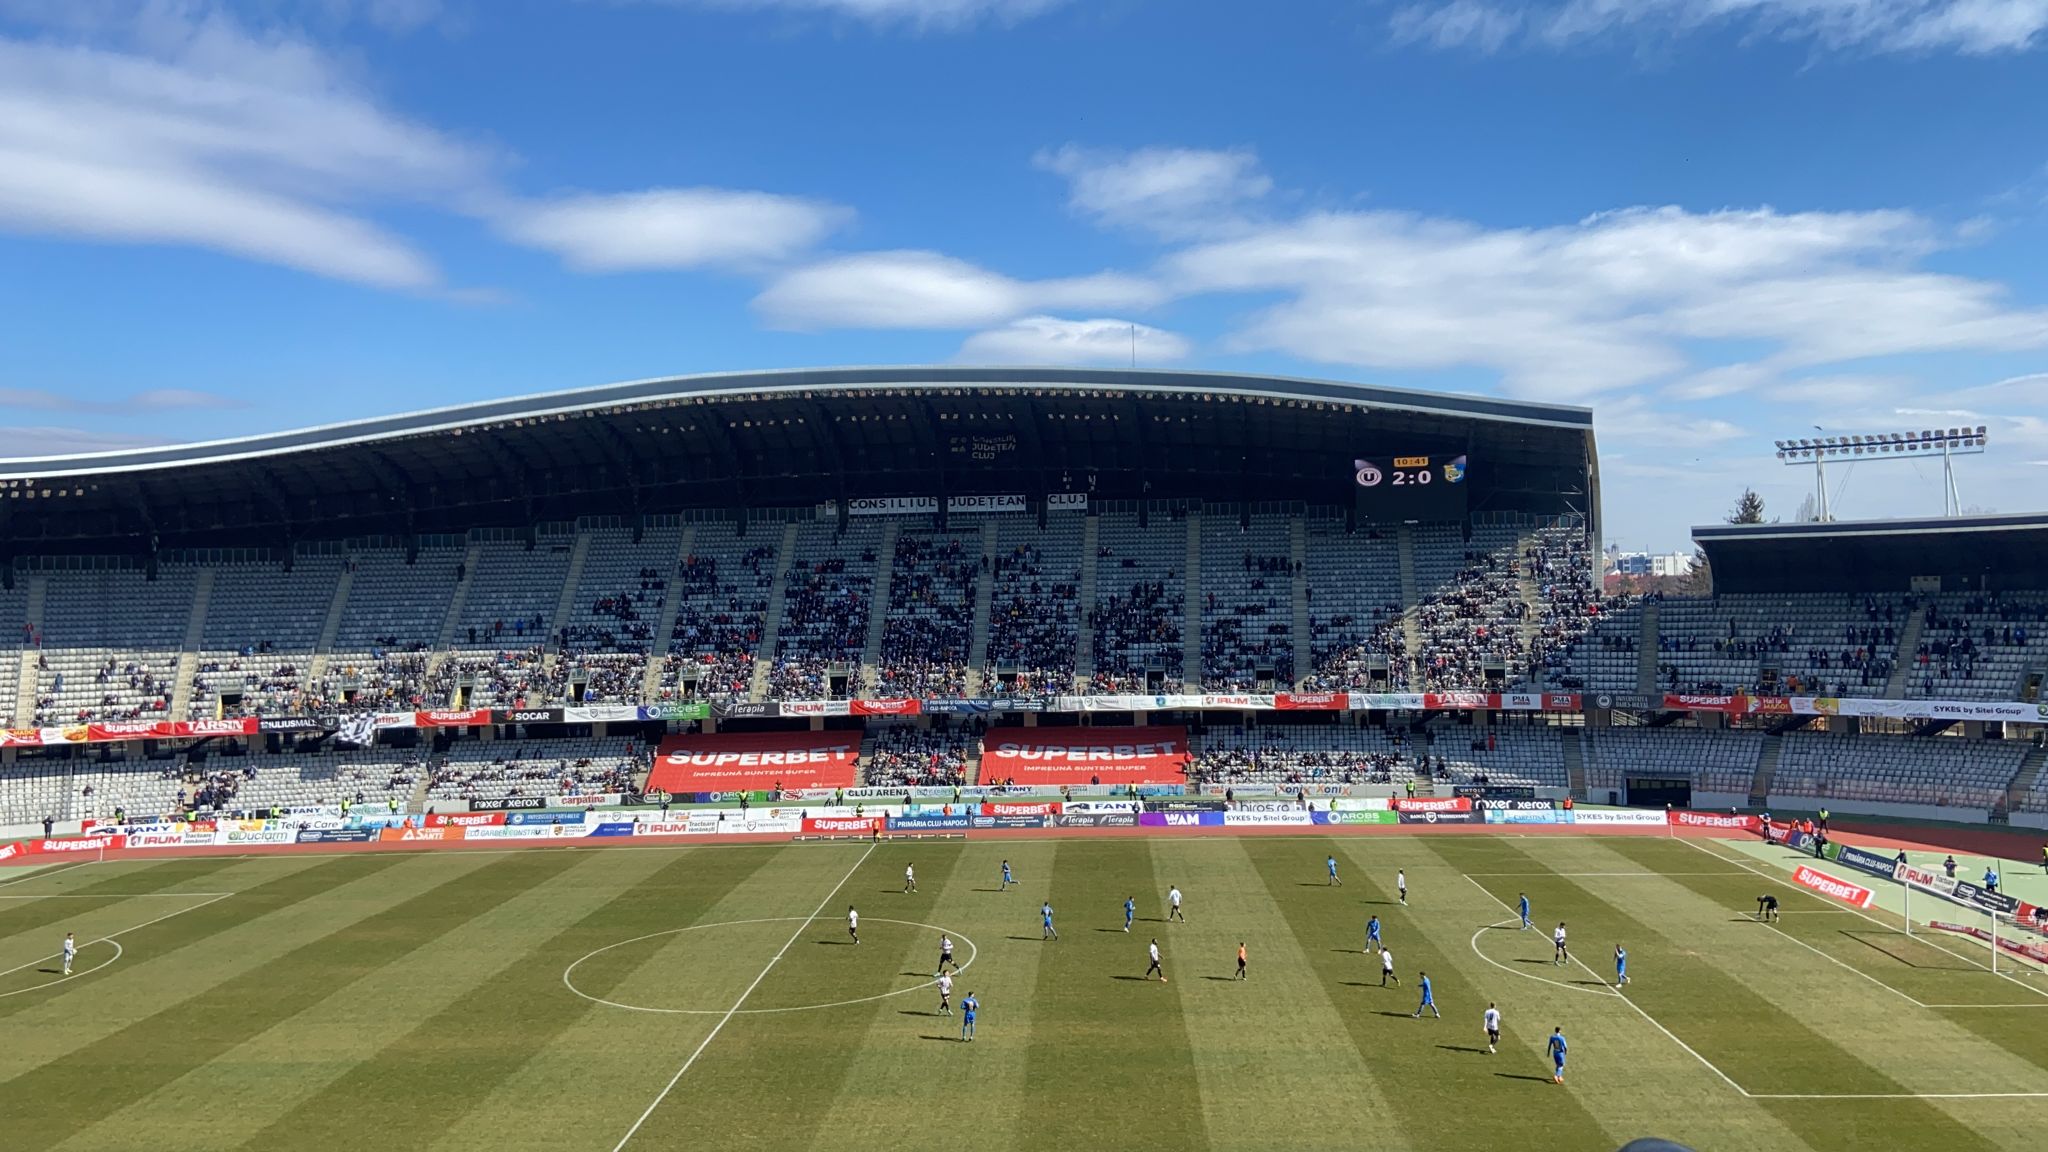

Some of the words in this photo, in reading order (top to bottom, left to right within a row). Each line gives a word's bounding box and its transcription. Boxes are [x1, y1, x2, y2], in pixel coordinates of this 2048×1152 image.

[1392, 470, 1432, 485] 2:0
[850, 497, 937, 510] CONSILIUL
[1050, 494, 1086, 504] CLUJ
[1290, 694, 1336, 703] SUPERBET
[1680, 695, 1732, 704] SUPERBET
[734, 704, 765, 714] Terapia
[794, 704, 824, 712] IRUM
[1996, 708, 2022, 716] Group
[430, 711, 477, 720] SUPERBET
[515, 712, 550, 720] SOCAR
[186, 720, 244, 730] TARSIN
[666, 745, 850, 766] SUPERBET
[995, 742, 1177, 761] SUPERBET
[507, 798, 540, 807] xerox
[561, 795, 606, 806] carpatina
[1400, 800, 1458, 810] SUPERBET
[1517, 801, 1551, 810] xerox
[994, 804, 1050, 815] SUPERBET
[1068, 816, 1094, 824] Terapia
[1108, 816, 1134, 824] Terapia
[1164, 814, 1200, 825] WAM
[1253, 814, 1261, 822] by
[1636, 814, 1660, 822] Group
[1679, 812, 1748, 827] SUPERBET
[314, 820, 338, 829] Care
[814, 819, 874, 830] SUPERBET
[42, 837, 113, 850] SUPERBET
[144, 836, 182, 845] IRUM
[1906, 870, 1934, 886] IRUM
[1799, 869, 1861, 900] SUPERBET
